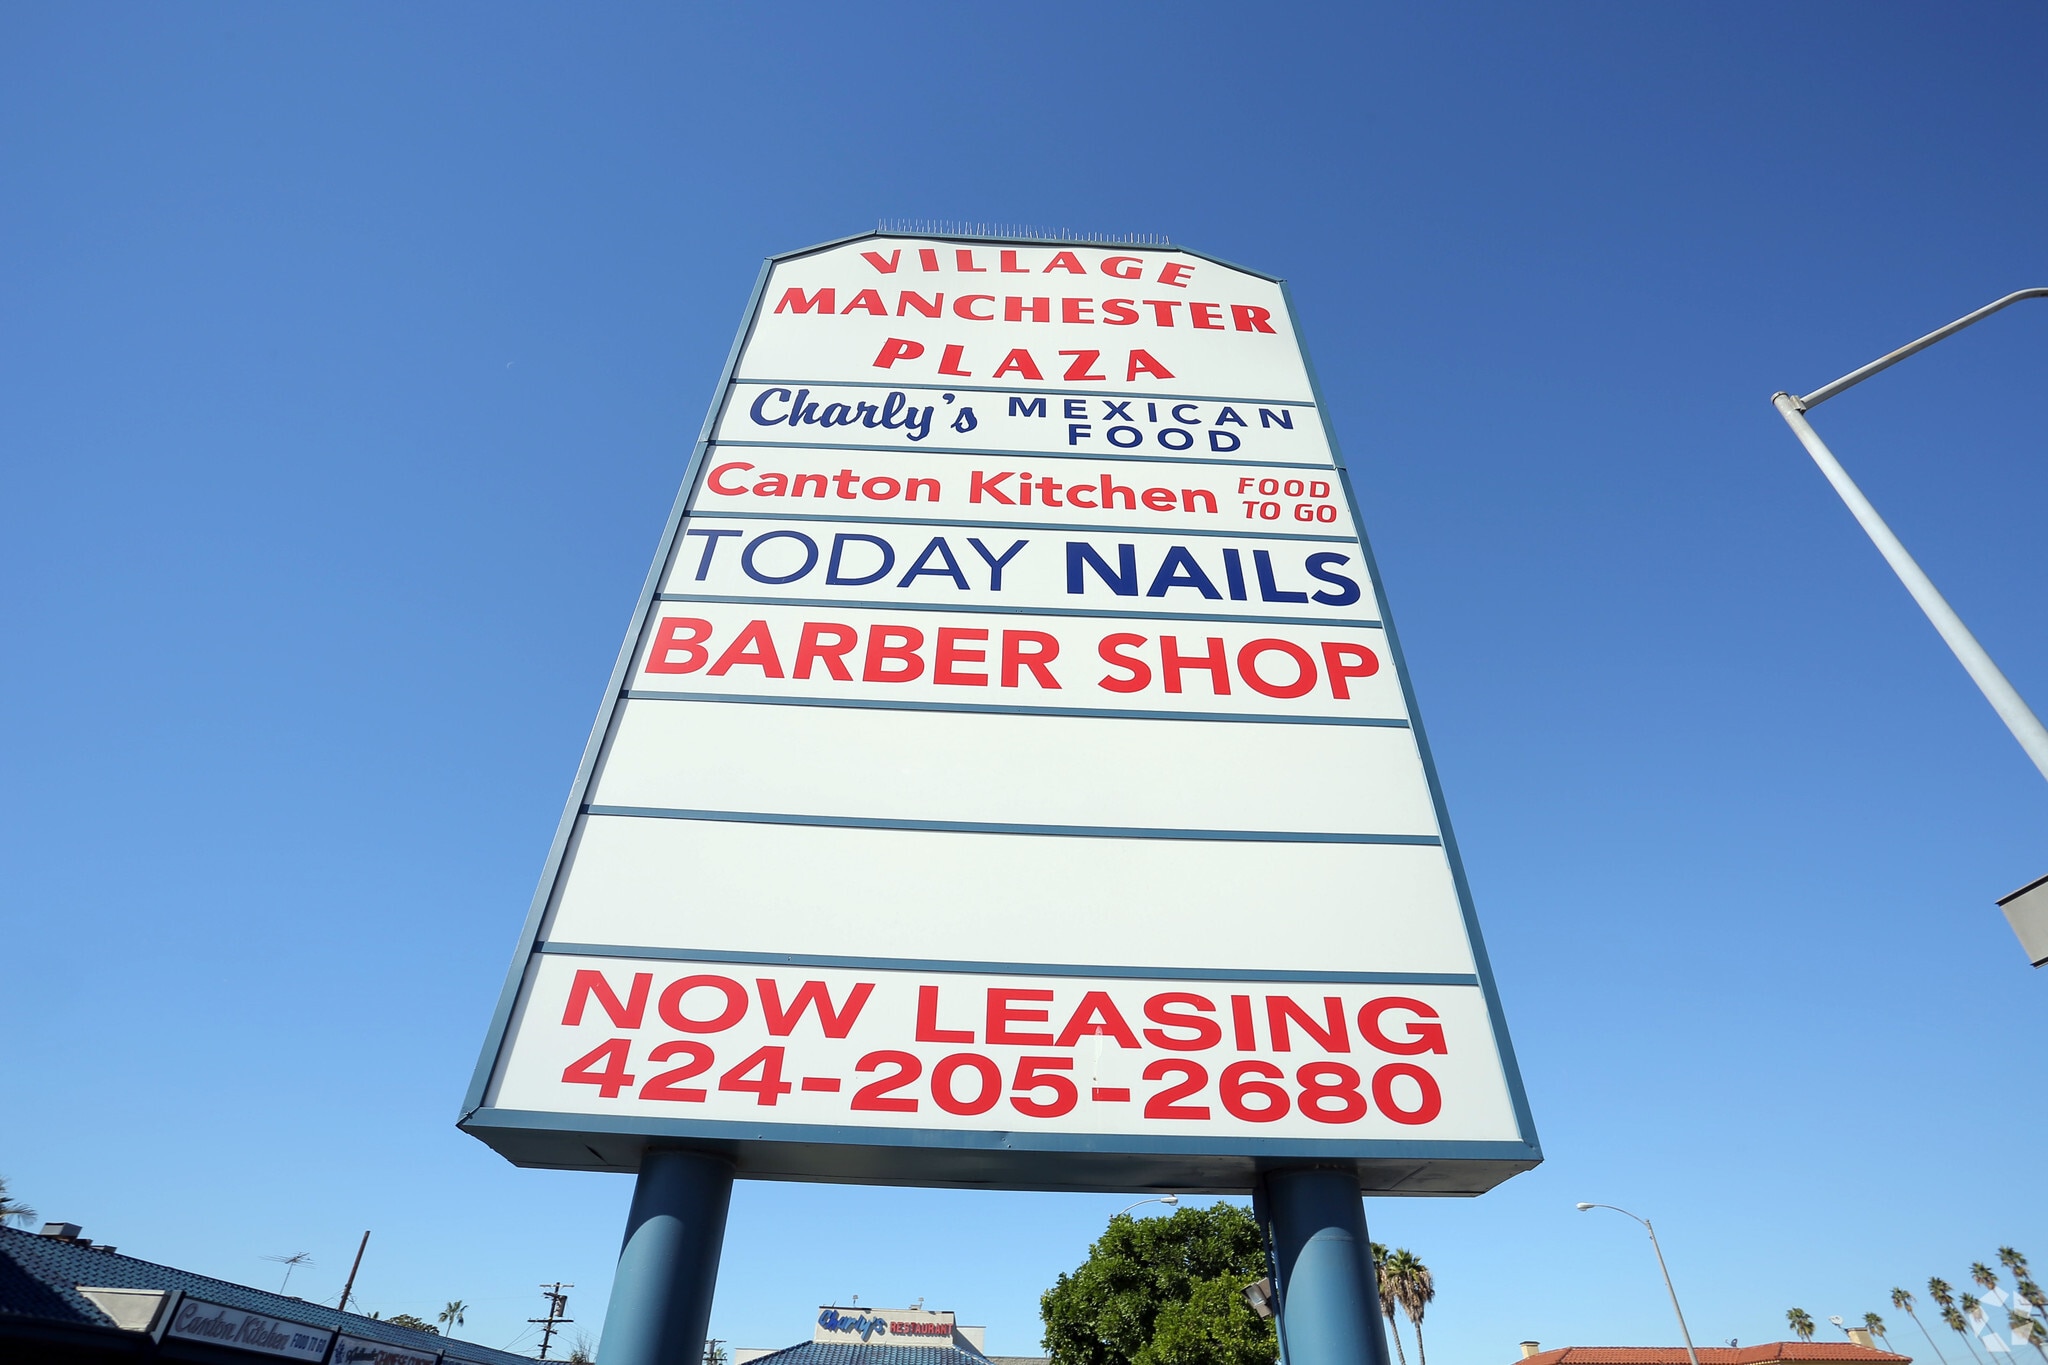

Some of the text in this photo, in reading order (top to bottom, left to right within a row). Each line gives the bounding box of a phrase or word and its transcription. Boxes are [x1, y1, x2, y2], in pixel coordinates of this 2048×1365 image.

[860, 248, 1196, 288] VILLAGE
[774, 287, 1277, 335] MANCHESTER
[873, 337, 1175, 382] PLAZA
[749, 387, 979, 442] Charly's
[1008, 396, 1294, 430] MEXICAN
[1068, 423, 1241, 453] FOOD
[707, 461, 1219, 514] Canton Kitchen
[1237, 477, 1331, 499] FOOD
[1242, 500, 1338, 523] TO GO
[686, 528, 1361, 607] TODAY NAILS
[645, 616, 1380, 701] BARBER SHOP
[562, 970, 1449, 1057] NOW LEASING
[562, 1037, 1443, 1126] 424-205-2680
[175, 1303, 290, 1350] Canton Kitchen
[818, 1309, 954, 1341] Charly's RESTAURANT
